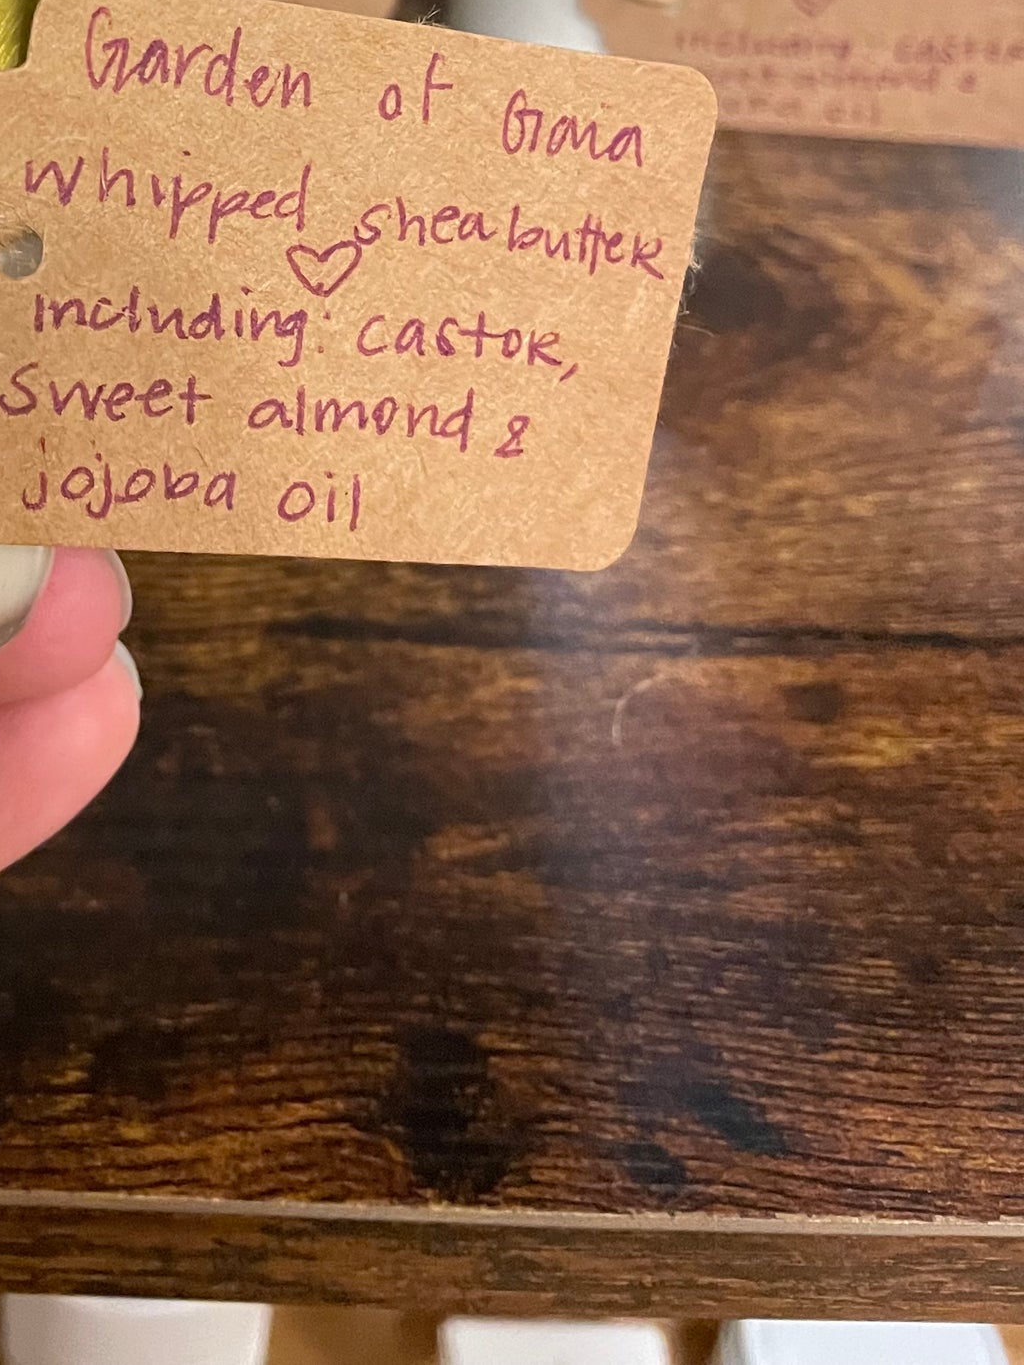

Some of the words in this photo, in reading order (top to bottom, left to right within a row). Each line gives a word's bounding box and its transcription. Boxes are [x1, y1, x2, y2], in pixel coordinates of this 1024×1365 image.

[84, 5, 312, 109] Garden
[377, 51, 454, 124] of
[501, 87, 644, 168] Gaia
[246, 383, 476, 454] almond
[20, 436, 238, 521] jojoba
[276, 469, 362, 533] oil
